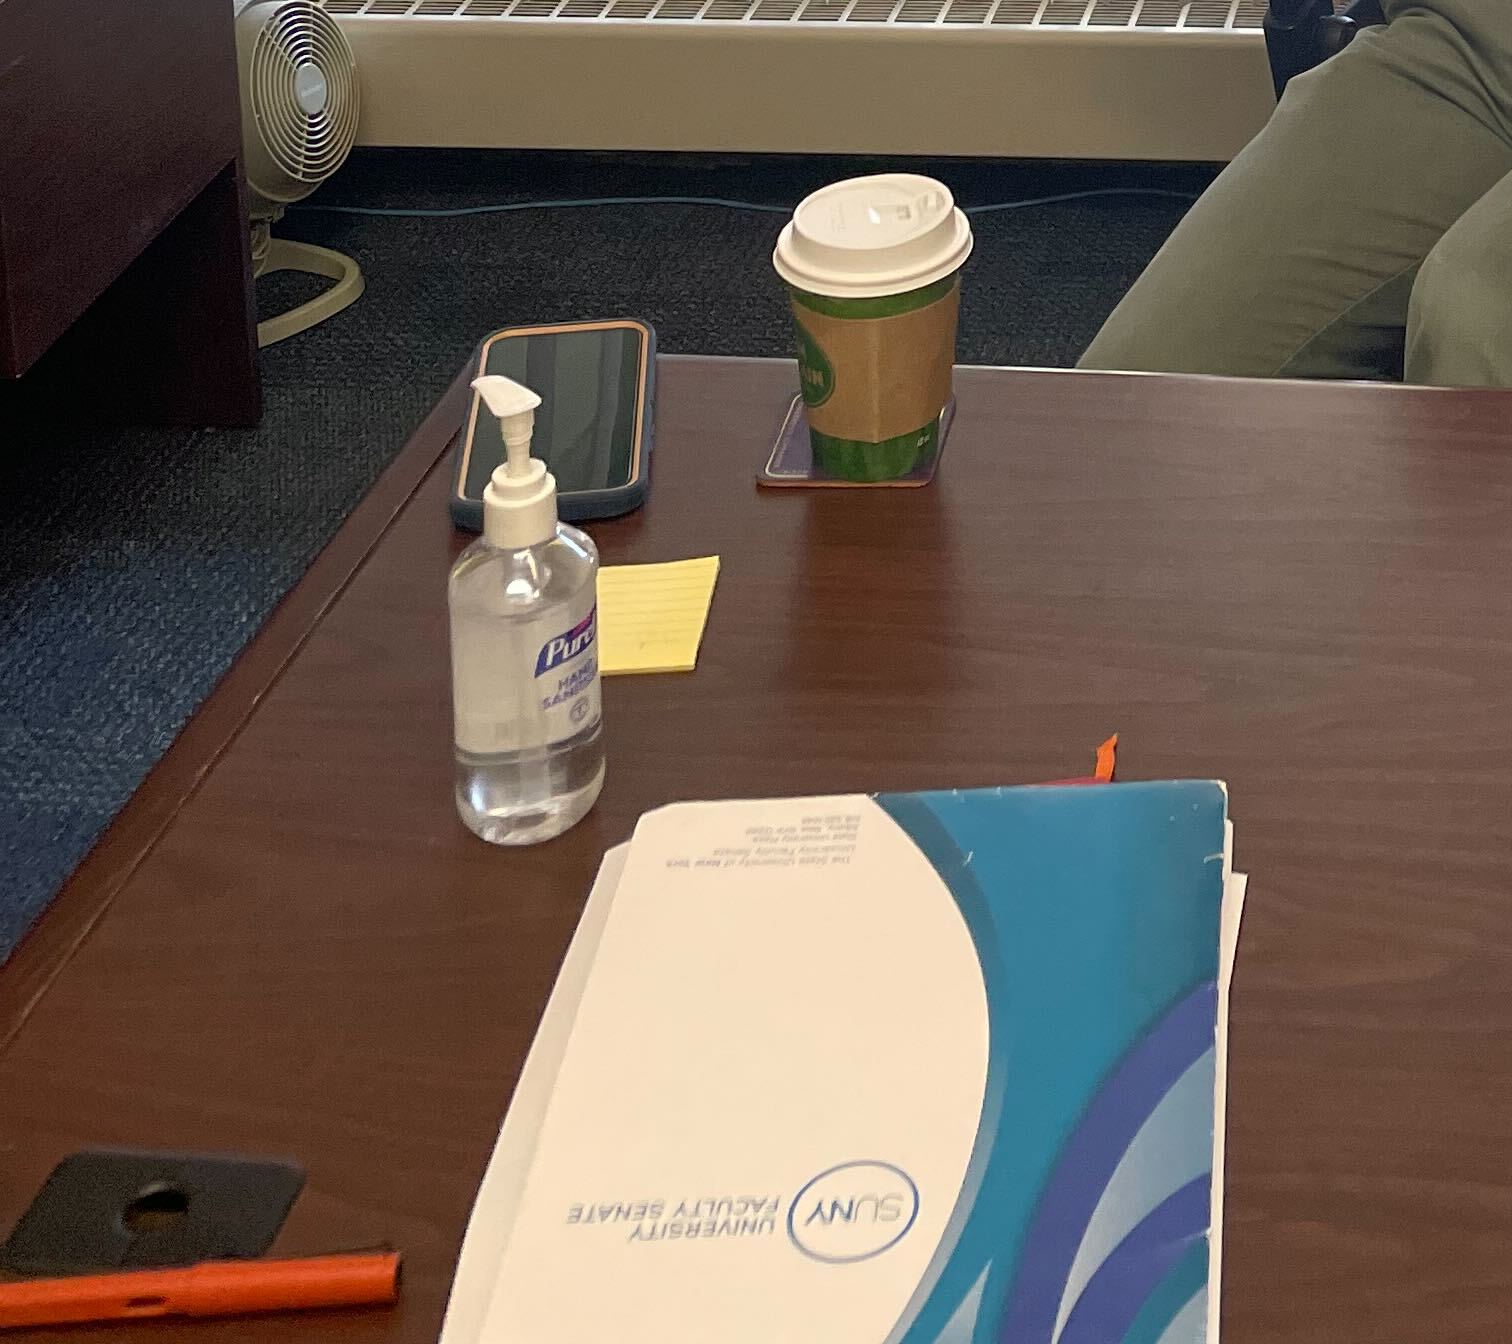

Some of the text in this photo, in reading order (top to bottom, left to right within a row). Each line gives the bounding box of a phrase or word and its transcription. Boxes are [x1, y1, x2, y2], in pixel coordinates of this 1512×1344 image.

[567, 1195, 781, 1225] FACULTY SENATE
[803, 1192, 905, 1228] SUNY
[627, 1218, 775, 1244] UNIVERSITY
